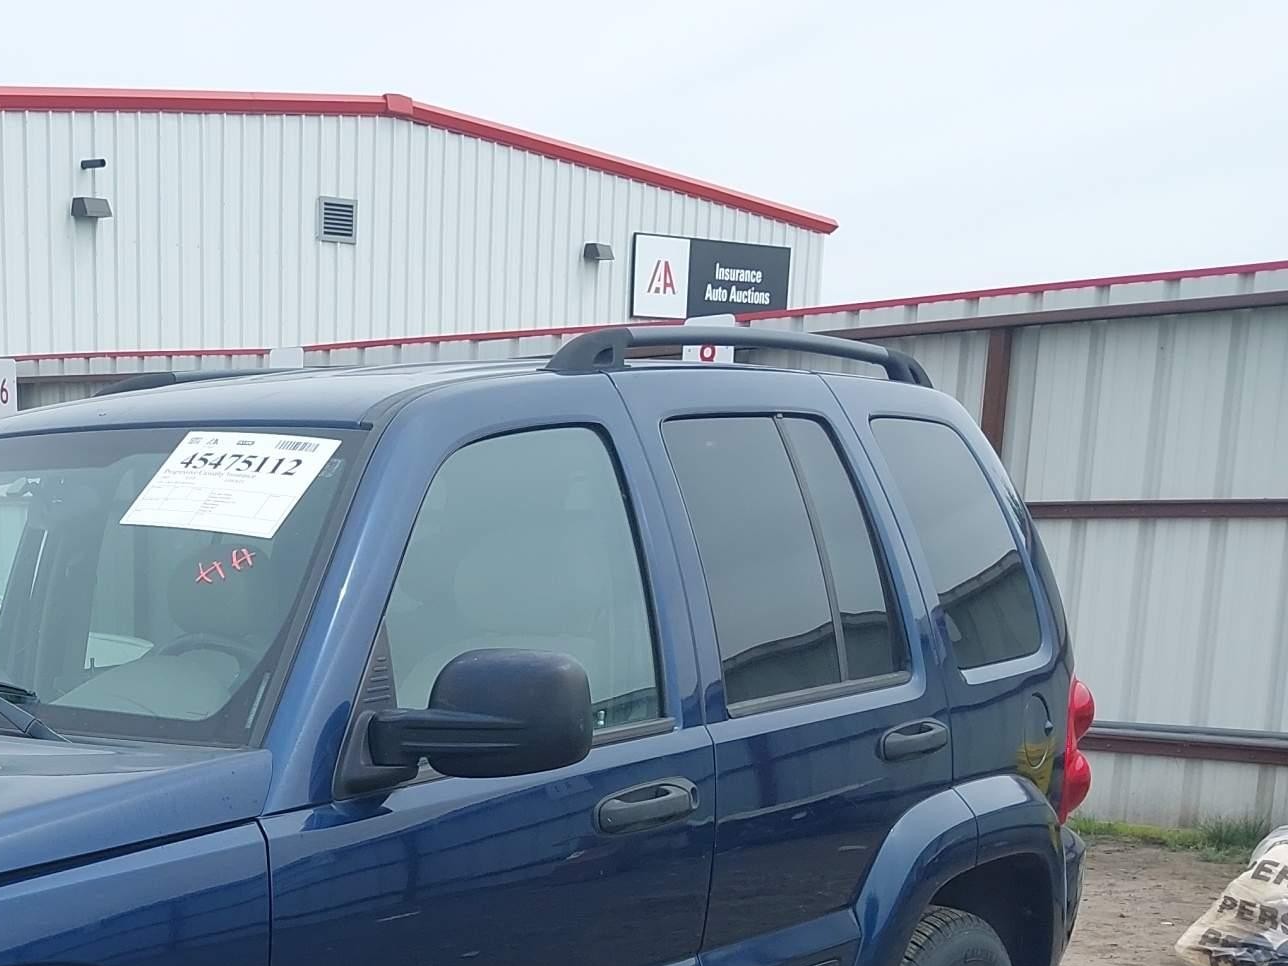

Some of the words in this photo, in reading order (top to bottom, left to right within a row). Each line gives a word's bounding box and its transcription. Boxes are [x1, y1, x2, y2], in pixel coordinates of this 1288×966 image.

[715, 262, 763, 284] Insurance
[704, 283, 728, 303] Auto
[729, 285, 771, 305] Auctions
[0, 378, 9, 404] 6
[179, 451, 303, 476] 45475112
